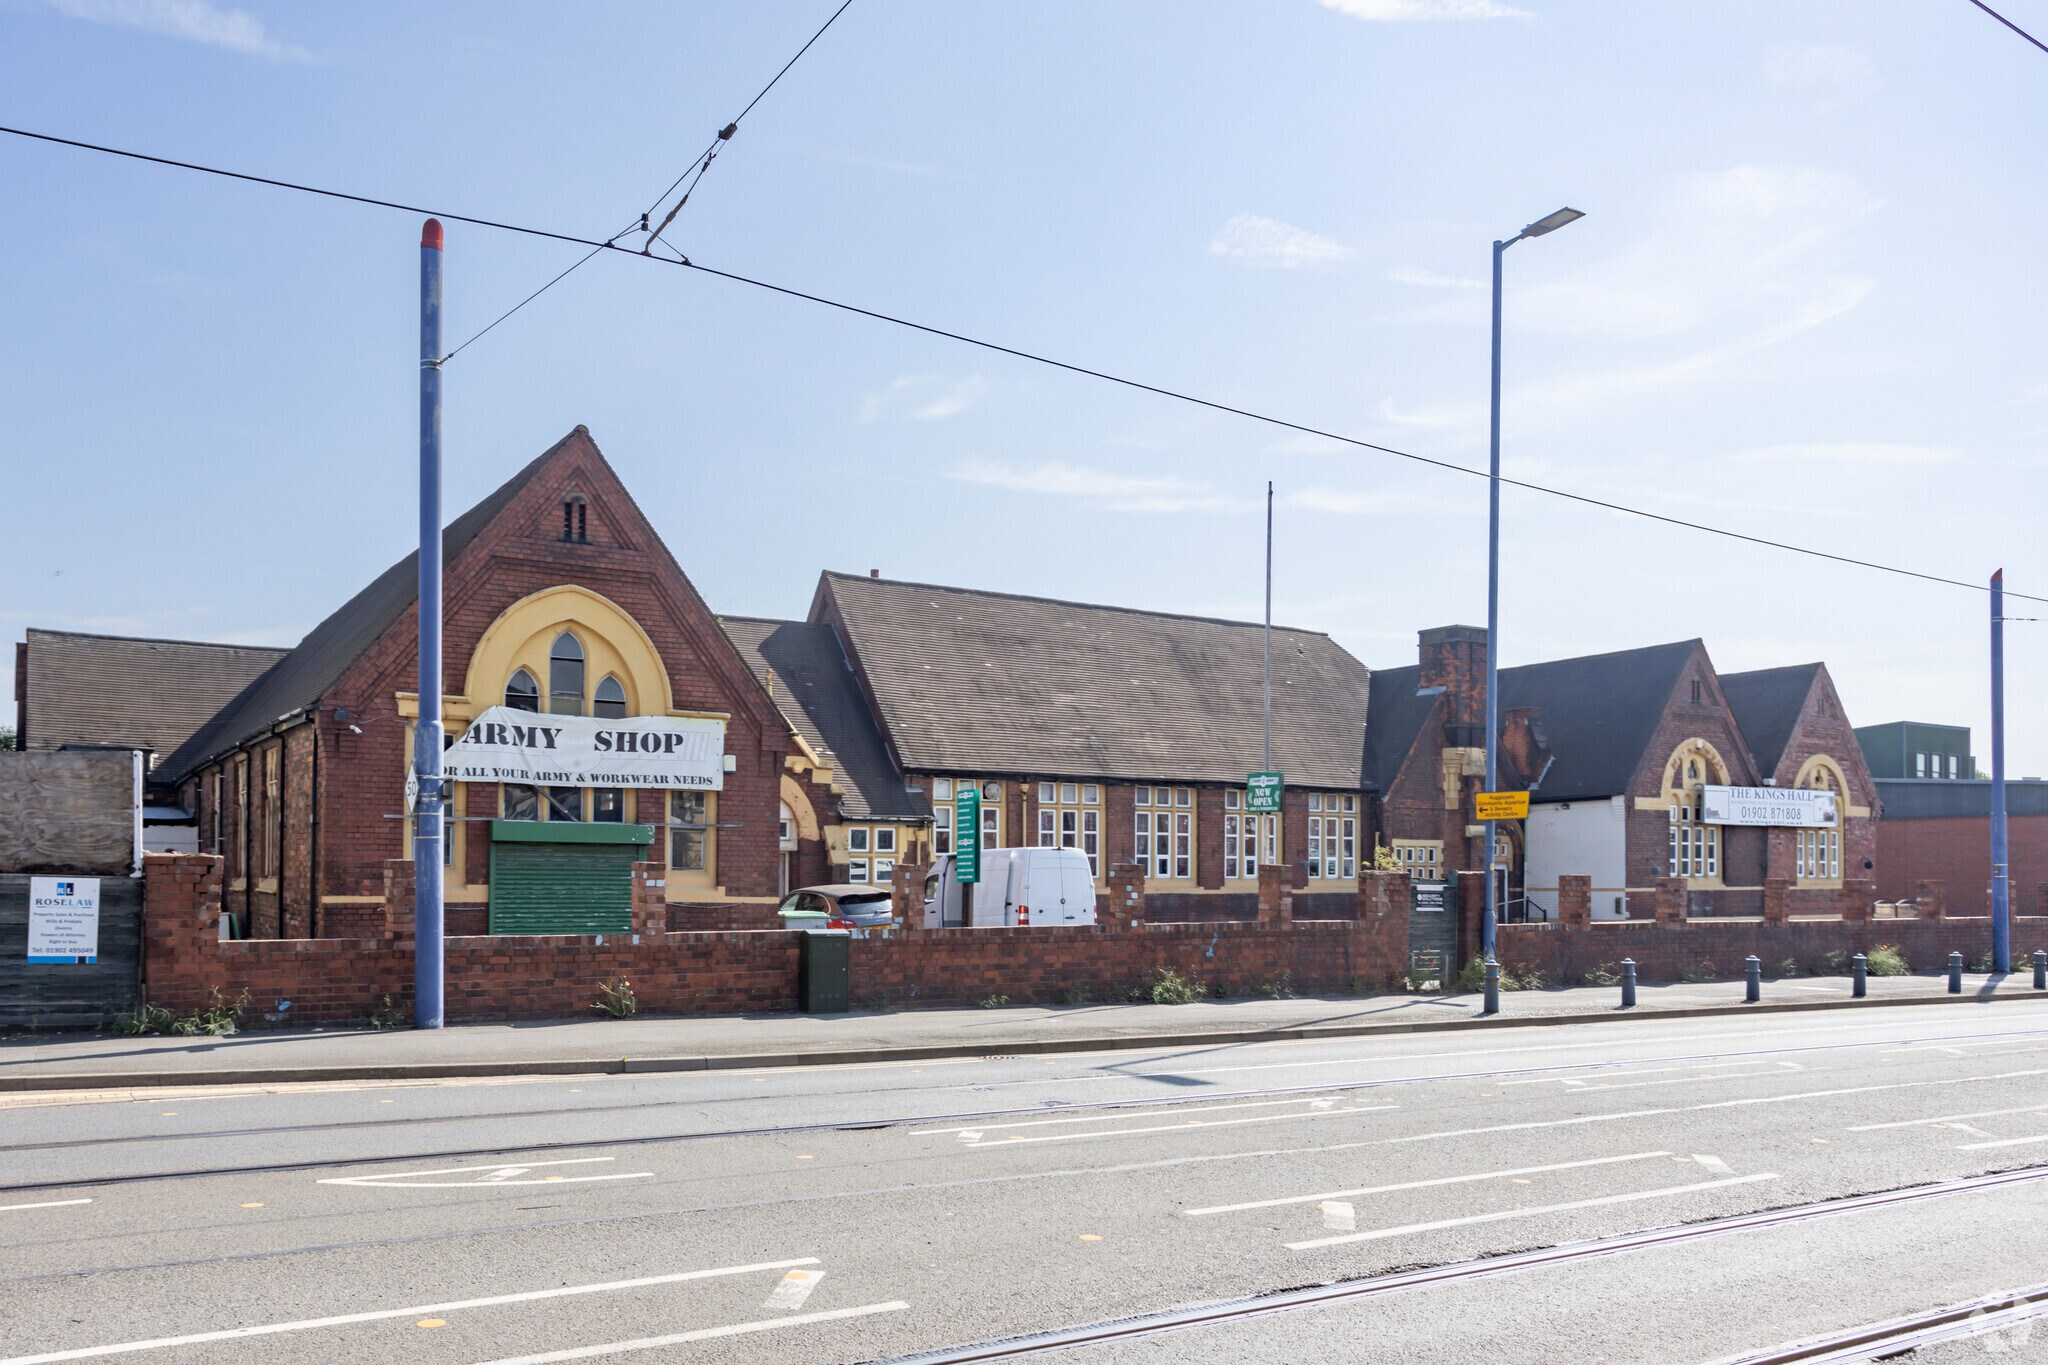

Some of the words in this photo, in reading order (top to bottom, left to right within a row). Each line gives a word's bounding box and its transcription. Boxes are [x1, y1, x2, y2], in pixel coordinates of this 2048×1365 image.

[461, 722, 563, 749] ARMY
[594, 730, 684, 753] SHOP
[462, 766, 489, 777] ALL
[492, 767, 530, 780] YOUR
[533, 771, 572, 782] ARMY
[576, 773, 586, 783] &
[590, 773, 669, 784] WORKWEAR
[673, 775, 713, 785] NEEDS
[407, 781, 416, 797] 50
[1255, 788, 1271, 797] NOW
[1730, 788, 1752, 799] THE
[1754, 789, 1786, 800] KINGS
[1787, 790, 1813, 801] HALL
[1253, 797, 1272, 806] OPEN
[1741, 806, 1767, 819] 01902
[1770, 807, 1801, 820] 871808
